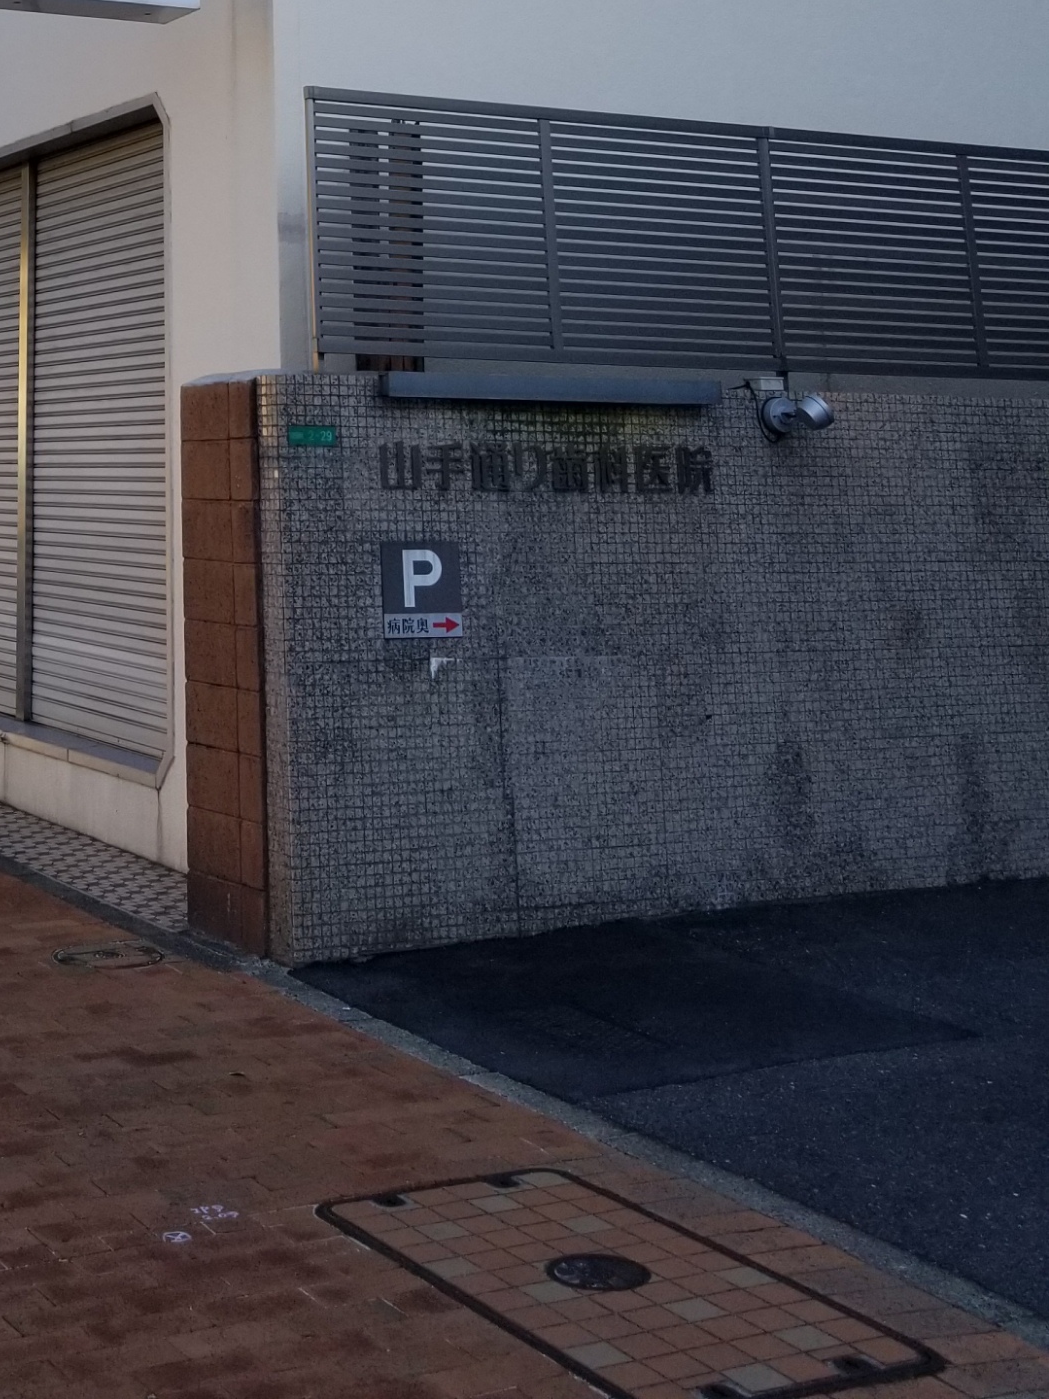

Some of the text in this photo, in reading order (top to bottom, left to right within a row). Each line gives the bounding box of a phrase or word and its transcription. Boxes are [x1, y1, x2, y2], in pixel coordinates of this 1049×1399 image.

[380, 441, 714, 493] 山手通り歯科医院
[402, 549, 442, 608] P
[387, 618, 429, 635] 病院奥
